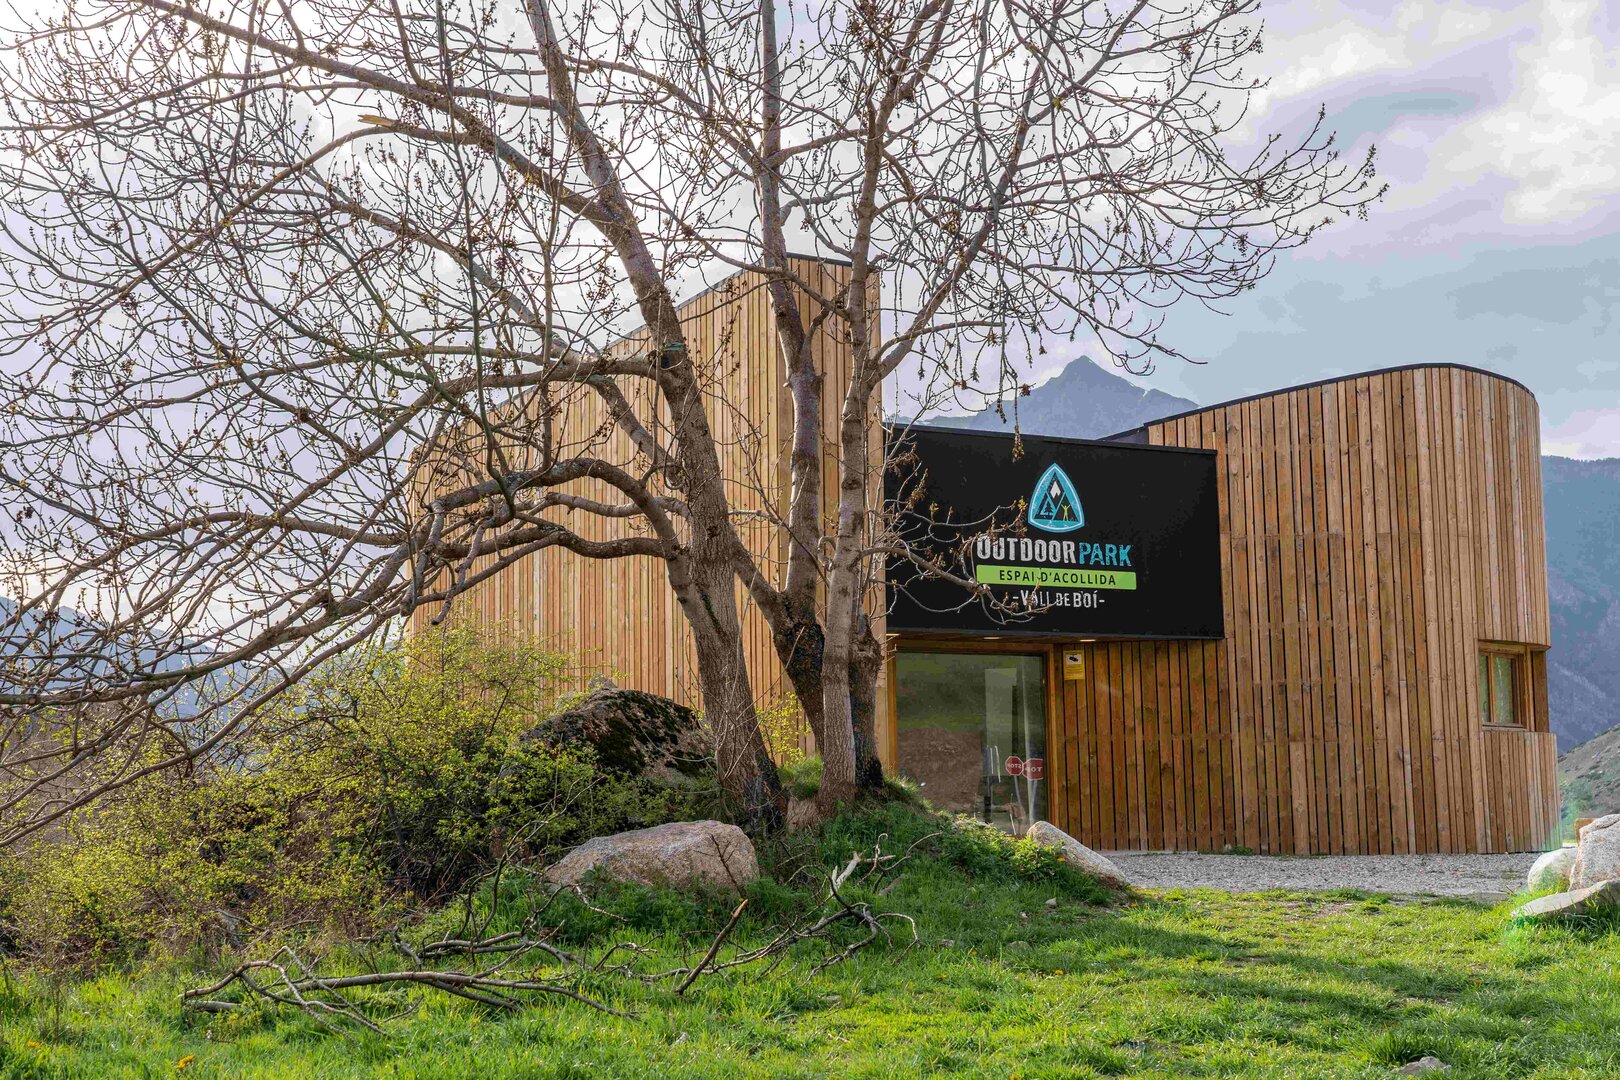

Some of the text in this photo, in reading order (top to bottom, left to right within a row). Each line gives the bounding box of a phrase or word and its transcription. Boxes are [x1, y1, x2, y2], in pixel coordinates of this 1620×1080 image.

[999, 570, 1116, 586] ESPAI D'ACOLLIDA
[1056, 592, 1071, 607] DE
